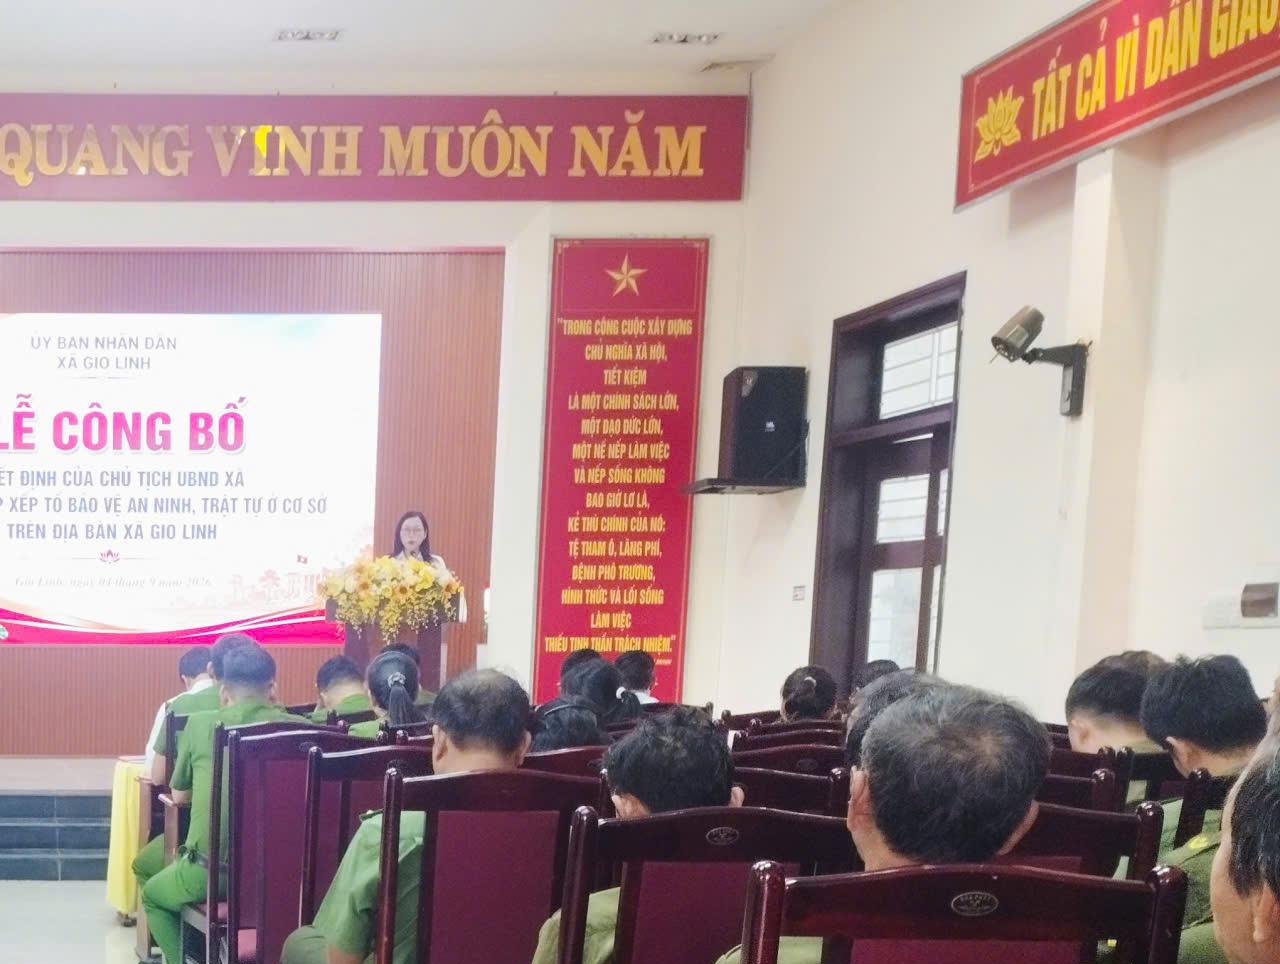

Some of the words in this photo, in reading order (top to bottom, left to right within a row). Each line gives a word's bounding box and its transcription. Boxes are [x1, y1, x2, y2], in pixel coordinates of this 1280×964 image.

[1032, 46, 1072, 141] TẤT
[1075, 17, 1107, 121] CẢ
[1114, 14, 1140, 103] VÌ
[207, 125, 362, 176] VINH
[379, 109, 562, 177] MUÔN
[568, 110, 707, 177] NĂM
[594, 317, 619, 336] CÔNG
[621, 317, 645, 339] CUỘC
[648, 317, 664, 336] XÂY
[667, 320, 692, 339] DỰNG
[57, 336, 89, 350] BAN
[585, 340, 603, 360] CHỦ
[605, 342, 632, 360] NGHĨA
[83, 356, 110, 370] GIO
[115, 356, 151, 370] LINH
[604, 364, 621, 385] TIẾT
[623, 366, 647, 388] KIỆM
[568, 392, 579, 410] LÀ
[581, 392, 600, 414] MỘT
[602, 392, 630, 410] CHÍNH
[632, 392, 656, 410] SÁCH
[52, 402, 172, 451] CÔNG
[189, 397, 247, 451] BỐ
[20, 470, 57, 490] ĐỊNH
[62, 466, 94, 486] CỦA
[100, 466, 131, 487] CHỦ
[138, 470, 171, 491] TỊCH
[177, 471, 219, 487] UBND
[574, 465, 585, 483] VÀ
[587, 462, 605, 483] NẾP
[608, 462, 632, 483] SỐNG
[634, 465, 665, 483] KHÔNG
[127, 497, 148, 513] AN
[586, 493, 604, 508] BAO
[568, 512, 579, 532] KẺ
[600, 514, 628, 532] CHÍNH
[52, 524, 78, 543] ĐỊA
[150, 524, 176, 540] GIO
[182, 524, 217, 540] LINH
[569, 538, 578, 560] TỆ
[581, 541, 606, 556] THAM
[598, 562, 616, 580] PHÔ
[585, 584, 607, 605] THỨC
[609, 586, 621, 605] VÀ
[623, 584, 637, 605] LỐI
[639, 584, 664, 605] SỐNG
[591, 610, 610, 628] LÀM
[611, 610, 632, 632] VIỆC
